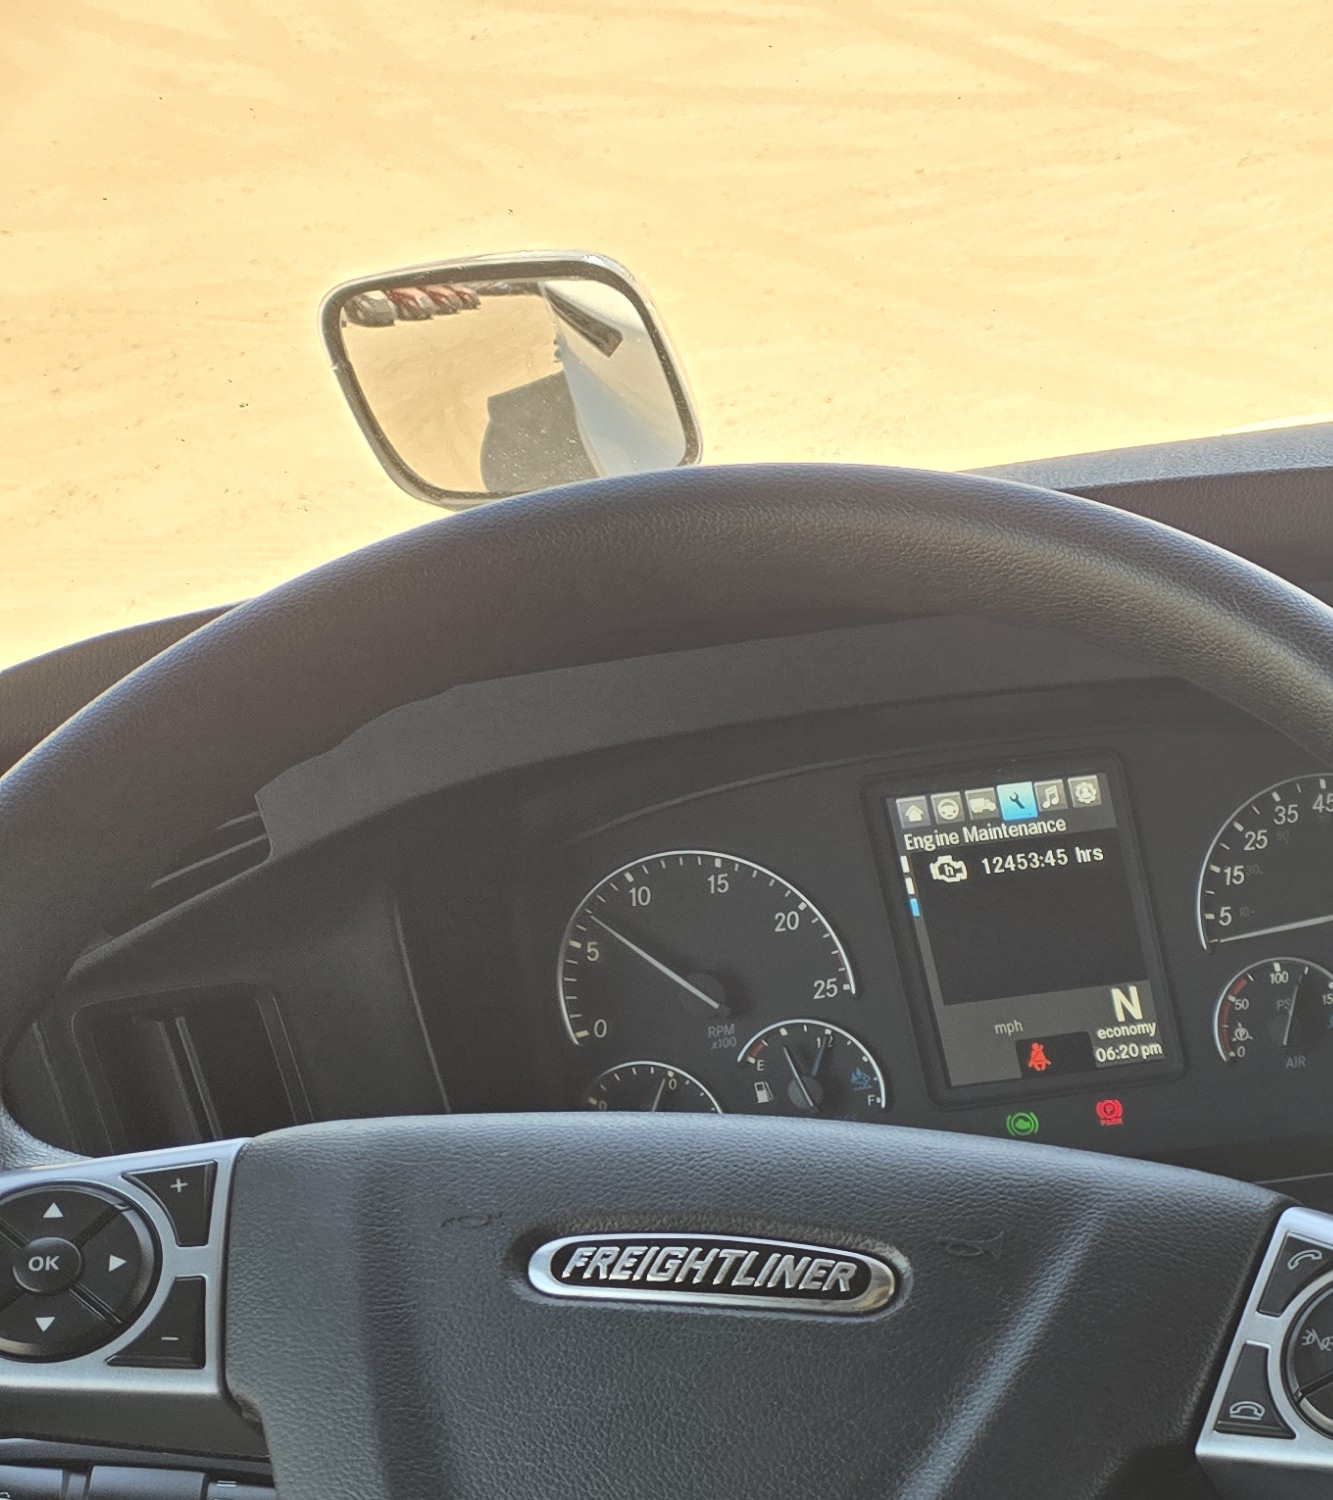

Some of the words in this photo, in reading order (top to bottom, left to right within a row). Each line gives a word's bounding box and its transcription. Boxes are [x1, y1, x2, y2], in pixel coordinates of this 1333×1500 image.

[1273, 804, 1299, 825] 35
[903, 828, 959, 851] Engine
[963, 817, 1067, 842] Maintenance
[1244, 830, 1268, 851] 25
[981, 849, 1068, 875] 12453:45
[1075, 845, 1104, 863] hrs
[708, 874, 730, 894] 15
[1224, 865, 1244, 886] 15
[629, 886, 651, 907] 10
[774, 912, 799, 932] 20
[1270, 971, 1289, 984] 100
[812, 980, 838, 999] 25
[1111, 986, 1143, 1022] N
[1234, 998, 1250, 1011] 50
[707, 1023, 736, 1038] RPM
[994, 1020, 1023, 1035] mph
[1097, 1021, 1157, 1040] economy
[1096, 1044, 1138, 1062] 06:20
[1141, 1042, 1162, 1060] pm
[1286, 1055, 1307, 1069] AIR
[28, 1256, 60, 1272] OK
[562, 1245, 858, 1293] FREIGHTLINER
